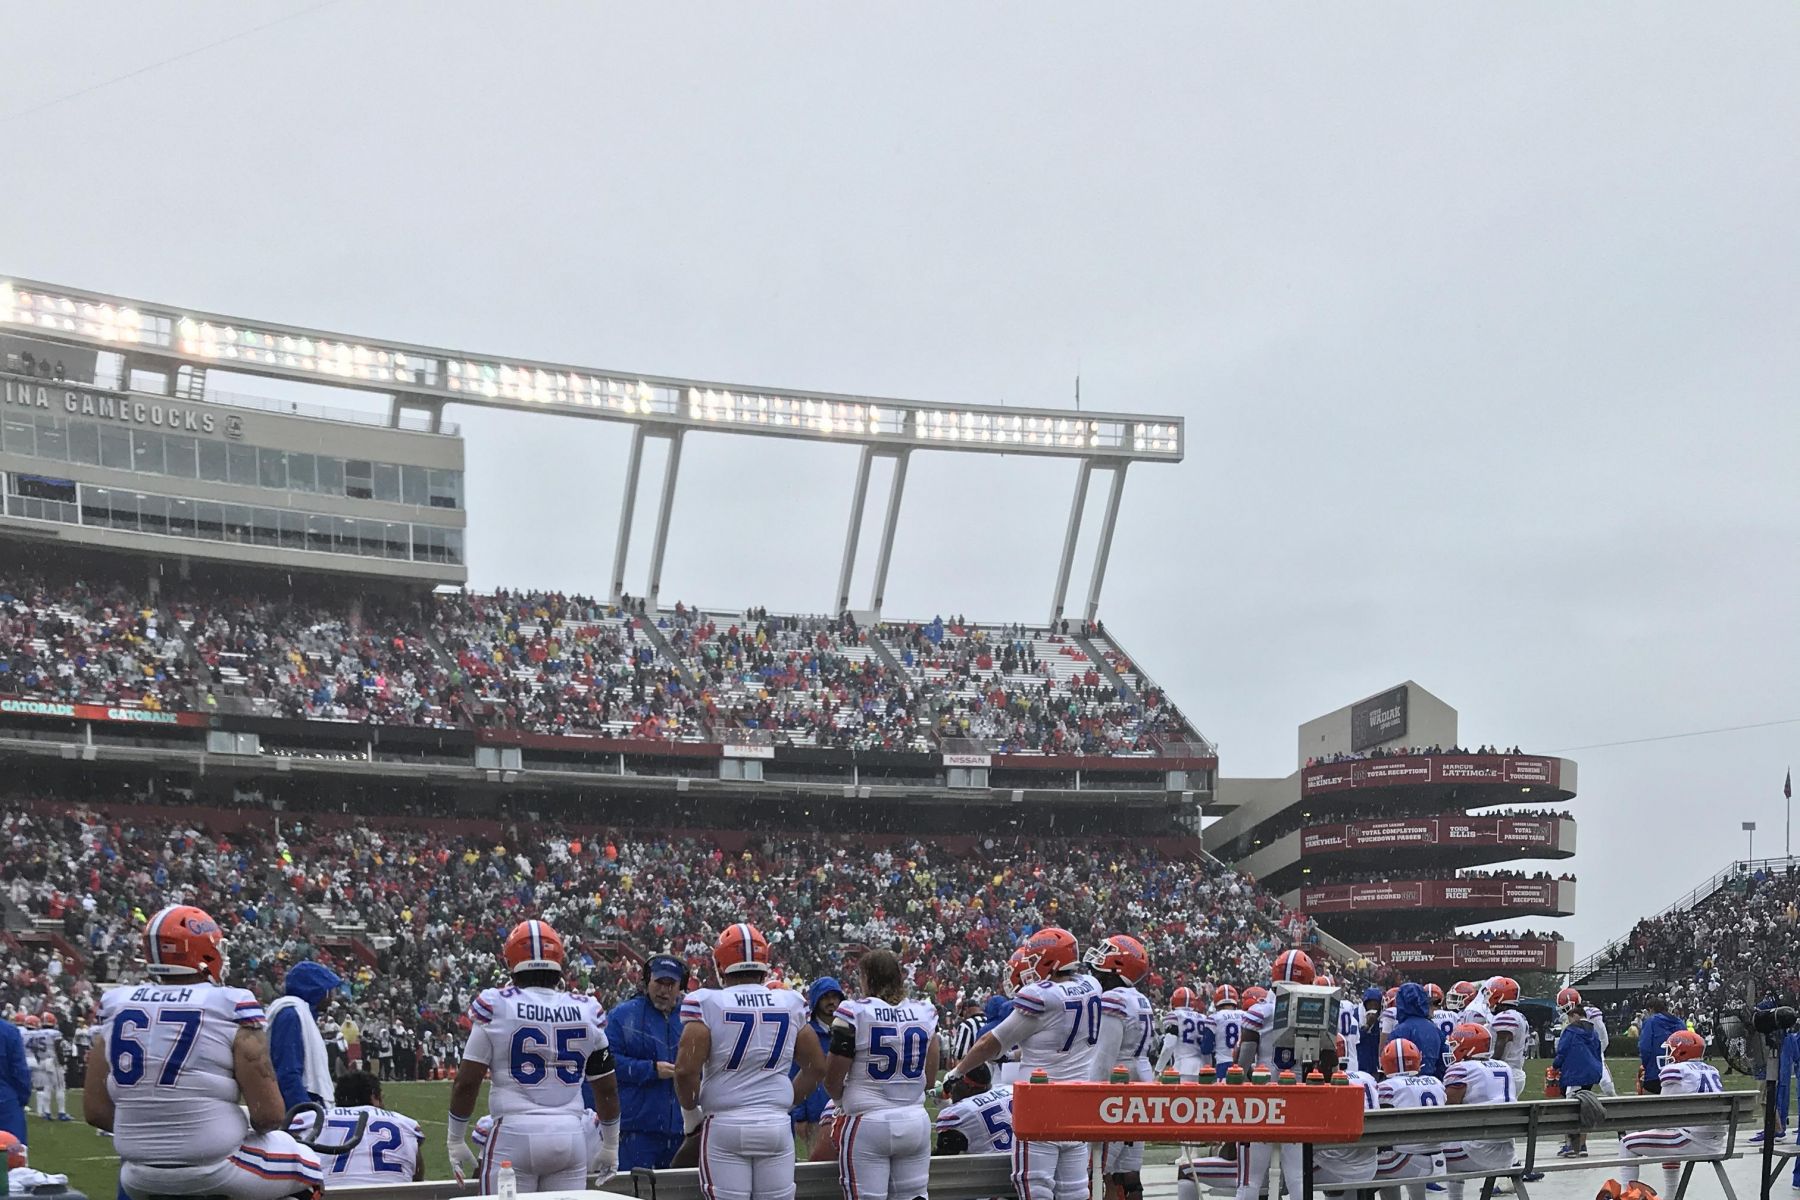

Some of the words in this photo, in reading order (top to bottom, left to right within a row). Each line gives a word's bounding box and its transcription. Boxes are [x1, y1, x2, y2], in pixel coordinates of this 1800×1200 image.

[5, 382, 50, 408] INA
[65, 391, 215, 434] GAMECOCKS
[1, 699, 75, 717] GATORADE
[107, 709, 178, 724] GATORADE
[1370, 706, 1400, 727] WADIAK
[1388, 768, 1428, 776] RECEPTIONS
[517, 1002, 582, 1023] EGUAKUN
[734, 993, 775, 1008] WHITE
[874, 1007, 919, 1023] ROWELL
[1063, 995, 1102, 1052] 70
[110, 1006, 205, 1089] 67
[723, 1010, 792, 1073] 77
[1226, 1022, 1239, 1049] 8
[509, 1025, 589, 1087] 65
[866, 1025, 930, 1082] 50
[1493, 1071, 1510, 1103] 7
[1099, 1096, 1287, 1124] GATORADE
[327, 1119, 404, 1174] 72
